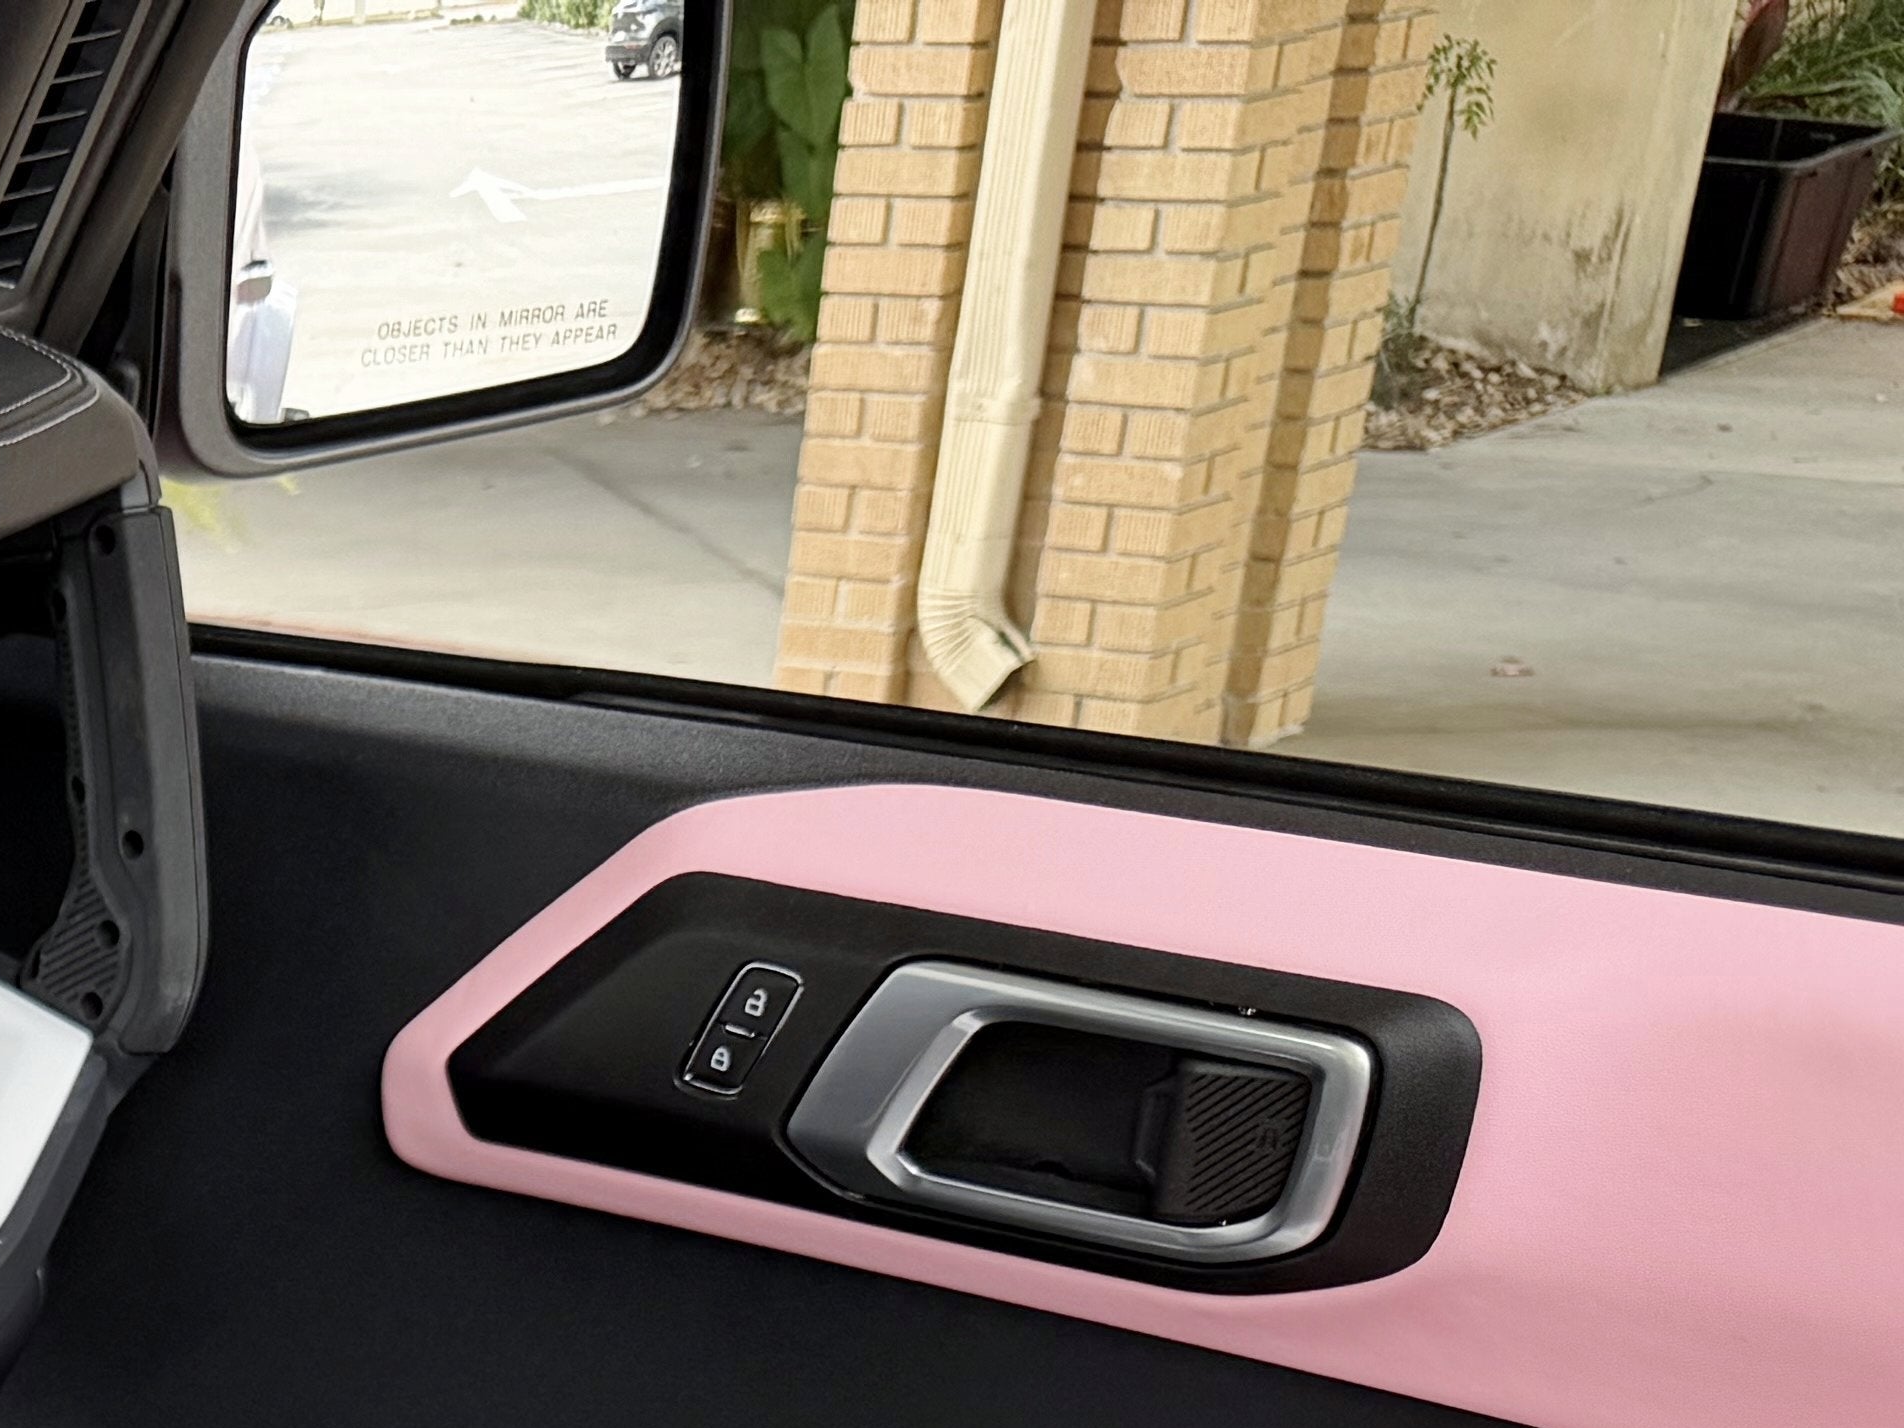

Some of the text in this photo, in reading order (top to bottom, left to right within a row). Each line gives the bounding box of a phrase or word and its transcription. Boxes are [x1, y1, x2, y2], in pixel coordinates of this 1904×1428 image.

[377, 300, 609, 341] OBJECTS IN MIRROR ARE
[361, 324, 617, 367] CLOSER THAN THEY APPEAR
